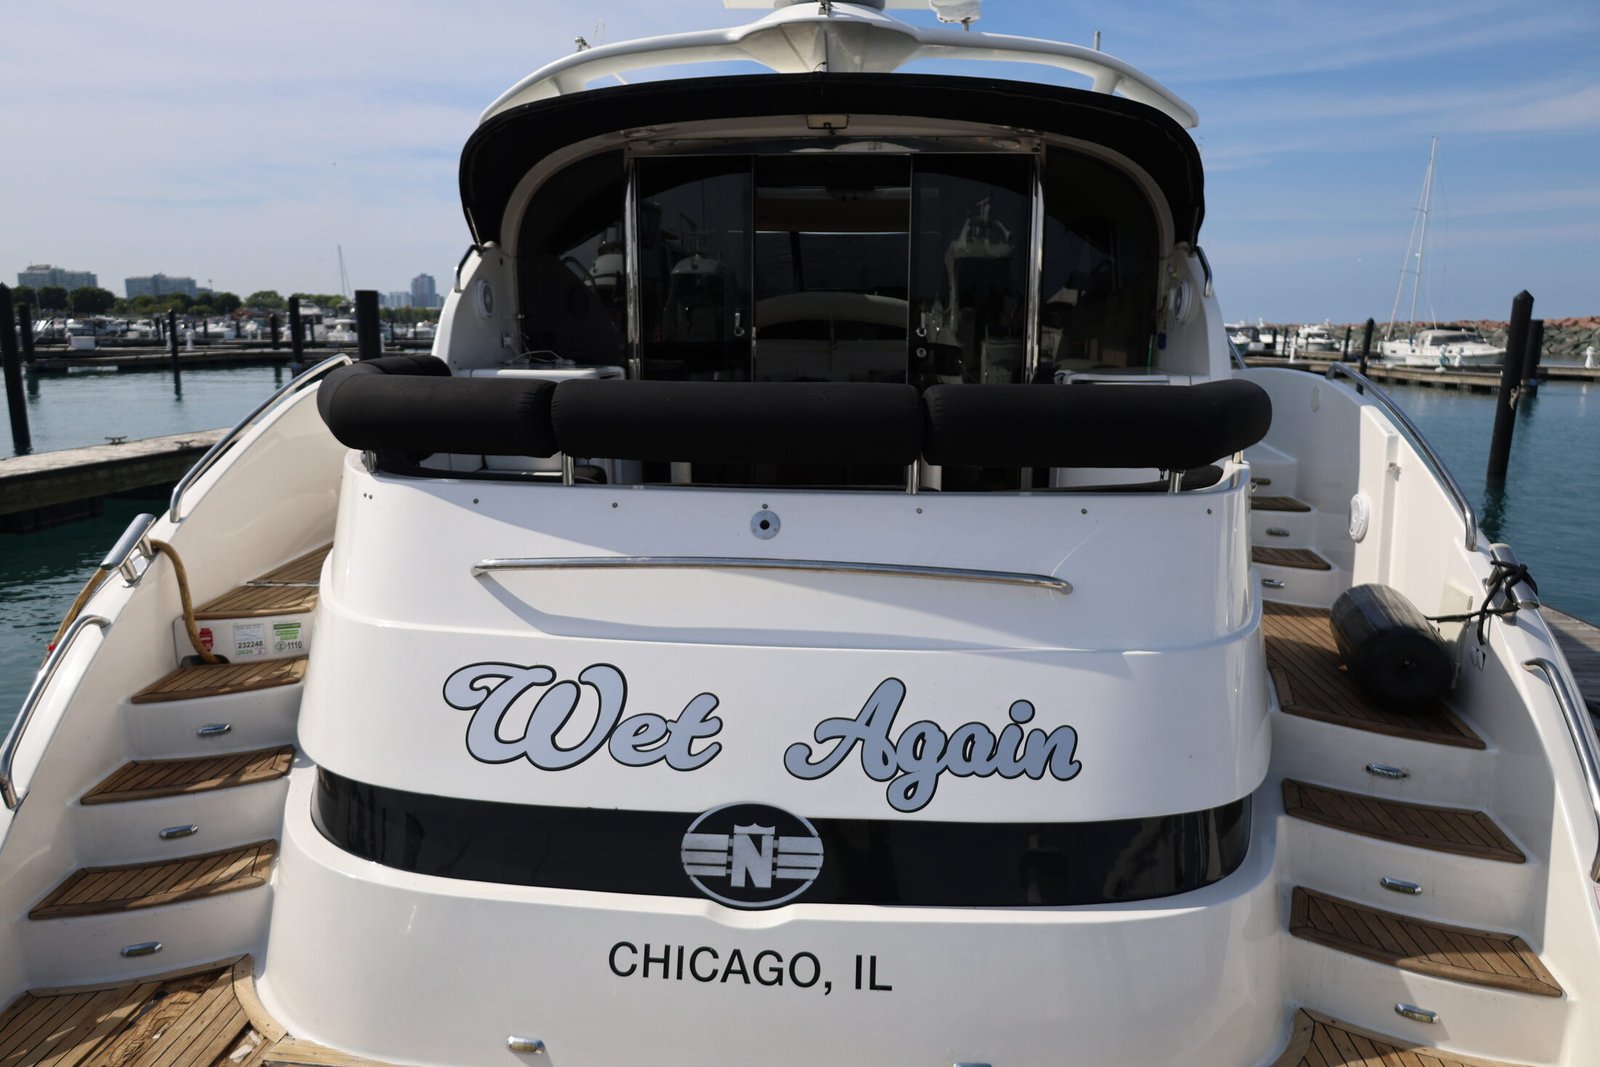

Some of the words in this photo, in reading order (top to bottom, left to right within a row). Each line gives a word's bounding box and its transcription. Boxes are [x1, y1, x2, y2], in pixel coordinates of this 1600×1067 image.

[287, 641, 303, 649] 1110
[442, 662, 723, 772] Wet
[783, 677, 1083, 813] Again
[608, 941, 832, 996] CHICAGO,
[855, 955, 893, 992] IL
